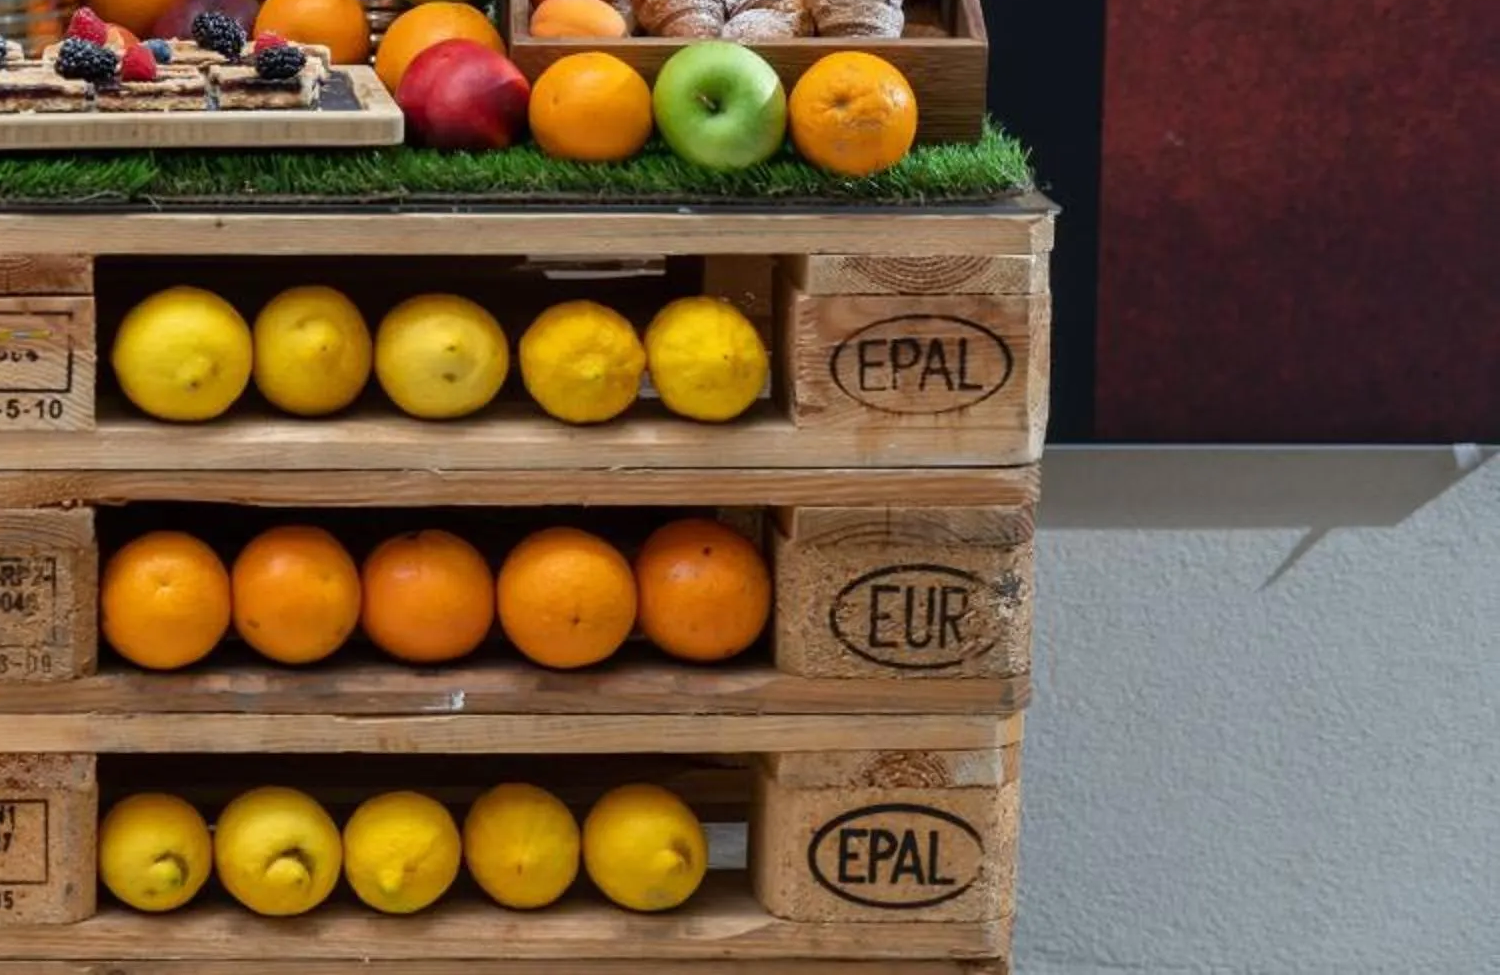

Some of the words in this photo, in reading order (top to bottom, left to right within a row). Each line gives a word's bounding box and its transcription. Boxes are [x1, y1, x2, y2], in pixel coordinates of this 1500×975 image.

[857, 337, 984, 391] EPAL
[868, 584, 970, 649] EUR
[837, 828, 957, 886] EPAL
